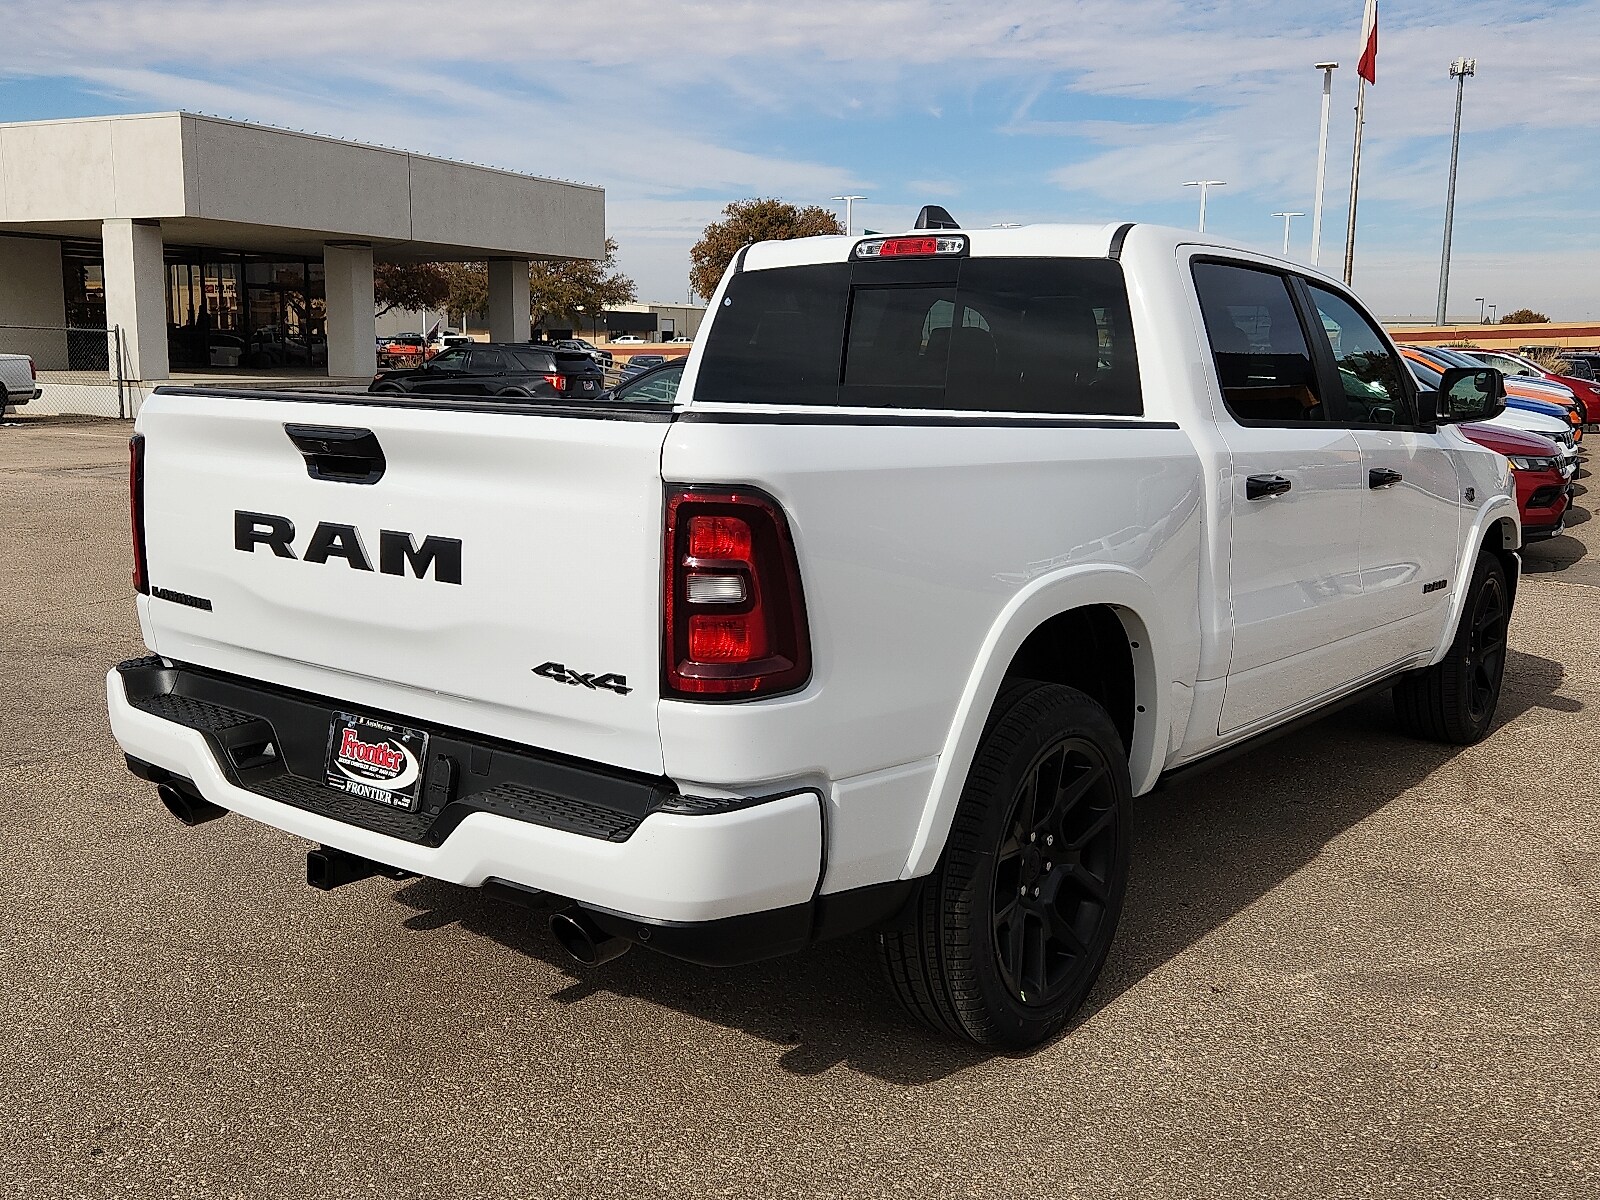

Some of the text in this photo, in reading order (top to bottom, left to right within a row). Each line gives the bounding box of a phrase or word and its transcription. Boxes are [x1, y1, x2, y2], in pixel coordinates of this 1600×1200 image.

[234, 509, 463, 585] RAM
[338, 728, 404, 772] Frontier
[345, 781, 392, 804] FRONTIER
